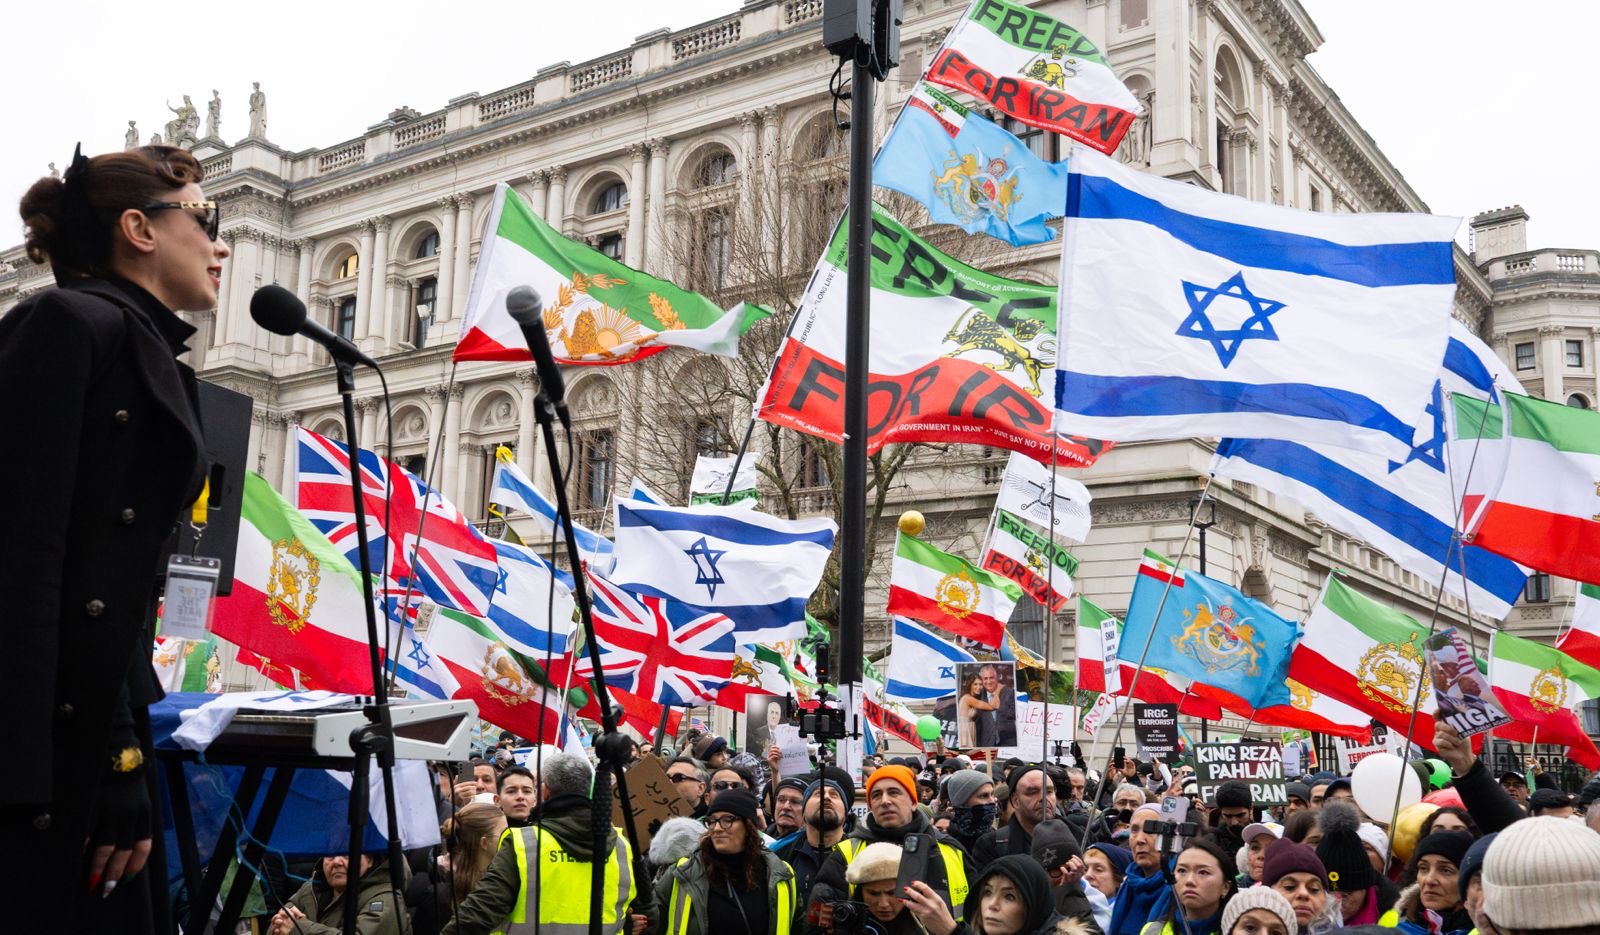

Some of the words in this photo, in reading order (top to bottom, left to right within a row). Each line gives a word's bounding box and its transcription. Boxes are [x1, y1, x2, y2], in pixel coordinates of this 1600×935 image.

[938, 51, 1019, 112] FOR
[1028, 86, 1124, 143] IRAN
[825, 273, 835, 287] LIVE
[788, 357, 940, 436] FOR
[899, 423, 950, 431] GOVERNMENT
[1009, 434, 1023, 444] SAY
[1025, 438, 1037, 448] NO
[1039, 442, 1050, 451] TO
[989, 552, 1026, 584] FOR
[1143, 708, 1168, 718] IRGC
[1196, 745, 1237, 763] KING
[1240, 746, 1282, 761] REZA
[1347, 749, 1388, 763] TERRO
[1208, 762, 1281, 780] PAHLAVI
[1249, 783, 1288, 803] RAN
